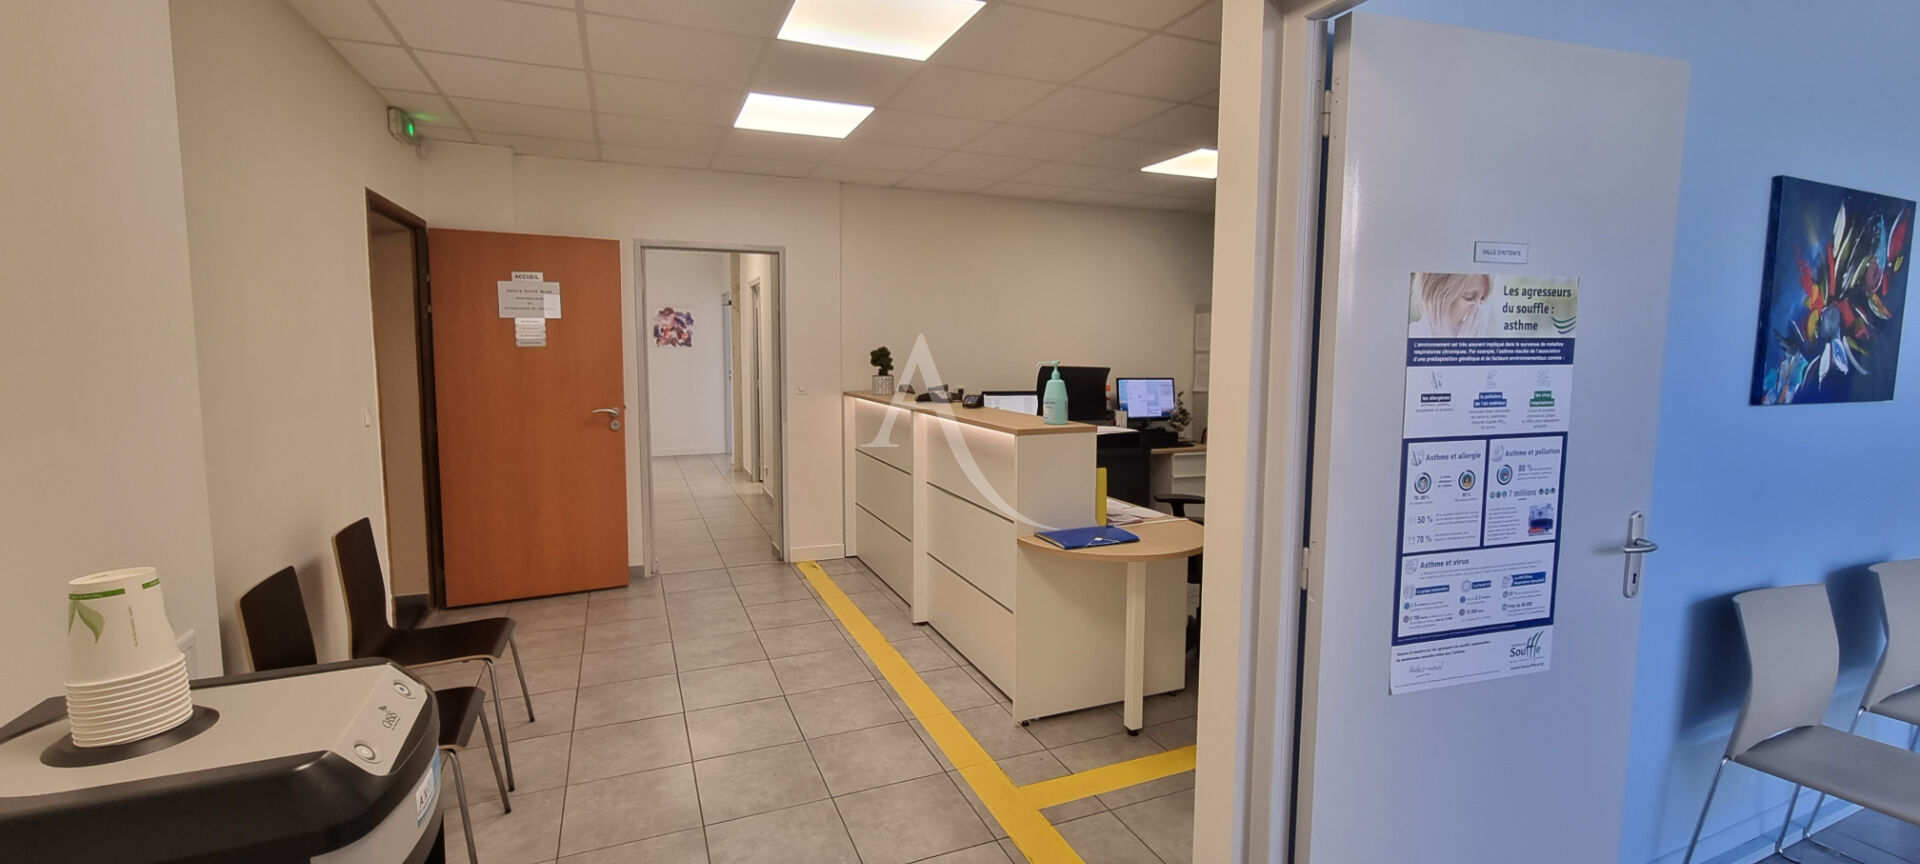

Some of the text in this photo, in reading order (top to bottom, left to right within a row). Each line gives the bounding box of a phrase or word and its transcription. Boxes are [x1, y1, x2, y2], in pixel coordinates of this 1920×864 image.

[1503, 285, 1572, 299] Les agresseurs
[1502, 303, 1515, 314] du
[1516, 303, 1549, 314] souffle
[1503, 320, 1538, 331] asthme
[1425, 453, 1449, 461] Asthme
[1457, 451, 1481, 461] allergie
[1504, 449, 1527, 457] Asthme
[1534, 447, 1560, 457] pollution
[1513, 488, 1537, 497] millions
[1417, 516, 1425, 524] 50
[1416, 535, 1424, 544] 70
[1419, 561, 1444, 569] Asthme
[1453, 558, 1469, 566] virus
[1509, 630, 1544, 661] Souffle
